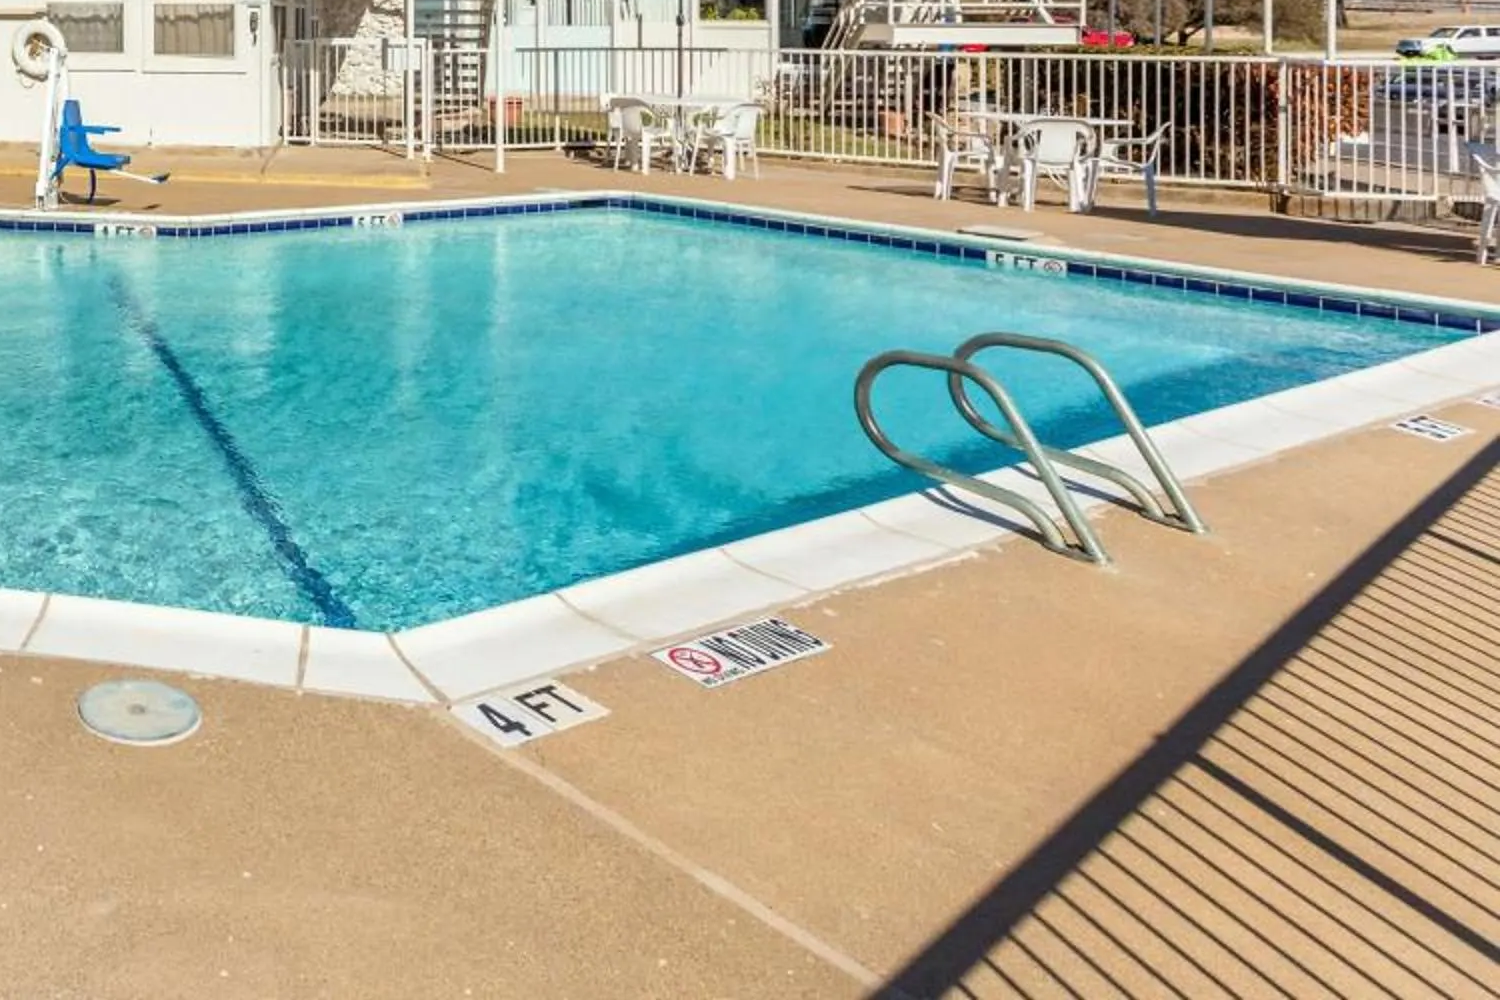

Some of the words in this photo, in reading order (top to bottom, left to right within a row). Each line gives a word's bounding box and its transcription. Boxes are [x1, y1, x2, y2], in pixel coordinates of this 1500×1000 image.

[699, 635, 766, 670] NO
[727, 618, 823, 660] DIVING
[476, 703, 533, 736] 4
[513, 684, 584, 723] FT
